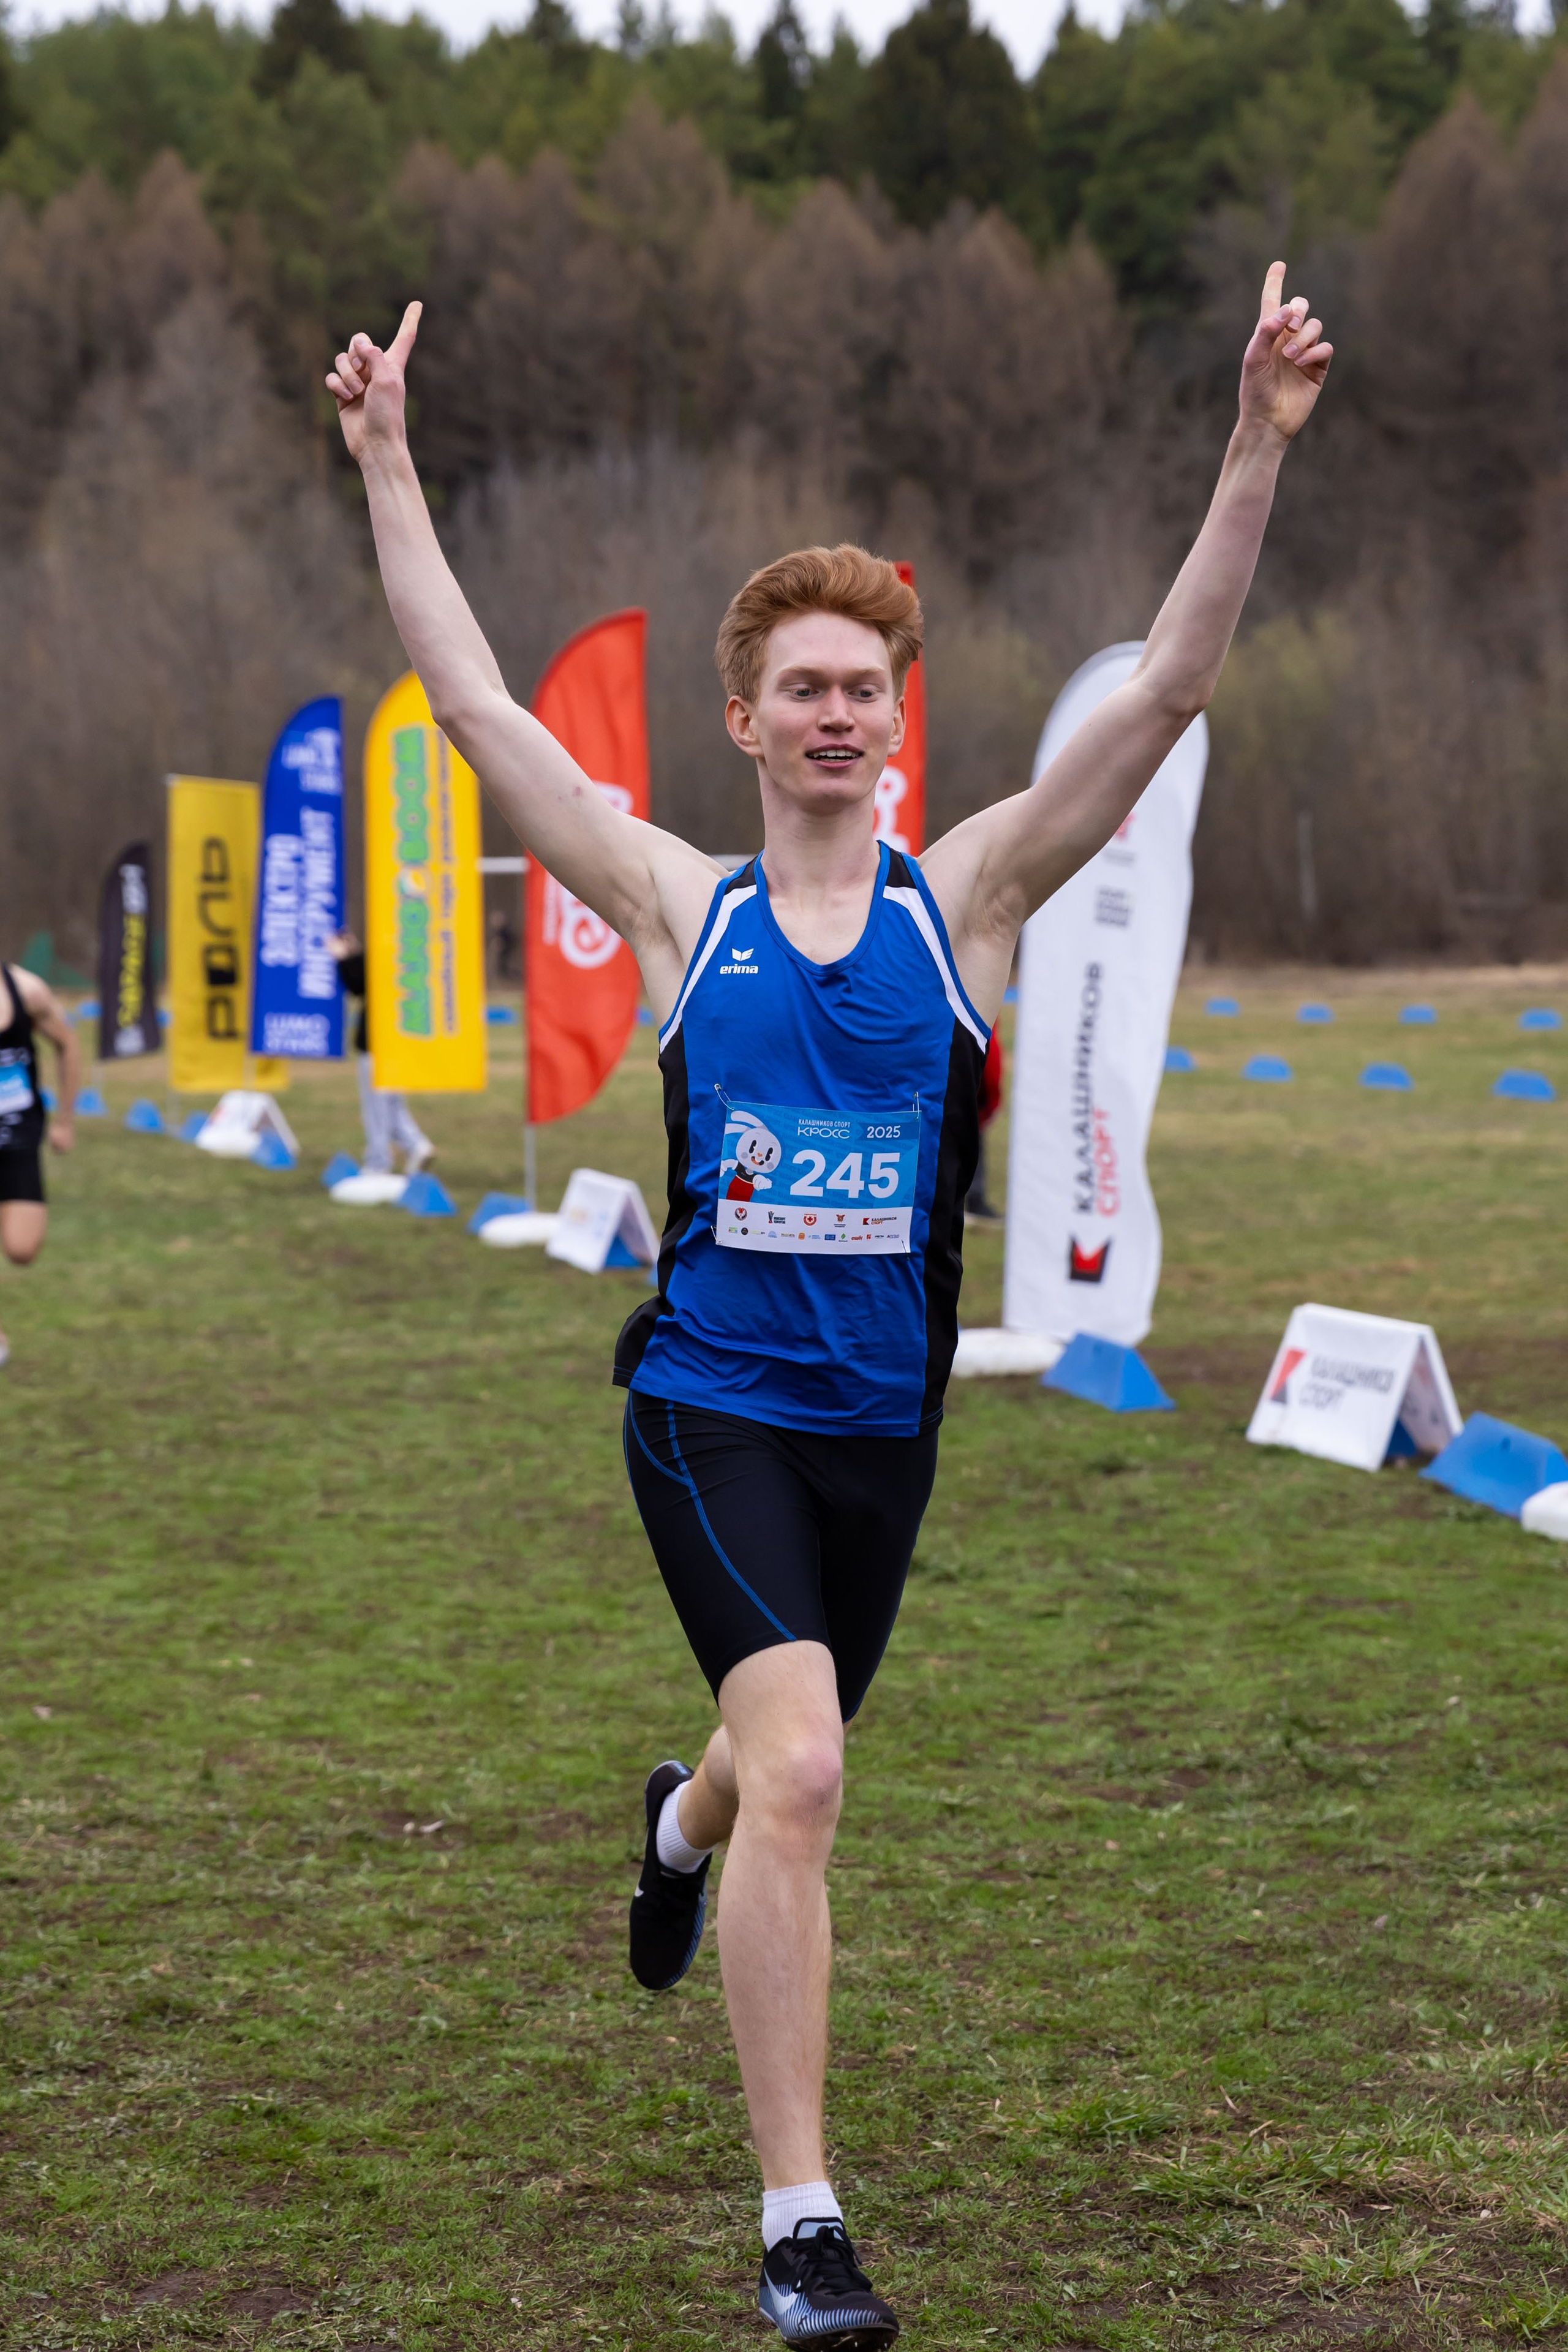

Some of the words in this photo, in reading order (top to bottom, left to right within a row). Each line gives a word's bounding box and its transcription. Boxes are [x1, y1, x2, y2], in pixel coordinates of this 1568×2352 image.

[720, 963, 759, 974] erima
[1070, 961, 1104, 1216] КАЛАШНИКОВ
[797, 1126, 850, 1139] КРОСС
[866, 1125, 901, 1139] 2025
[790, 1149, 900, 1199] 245
[1092, 1107, 1122, 1218] СПОРТ
